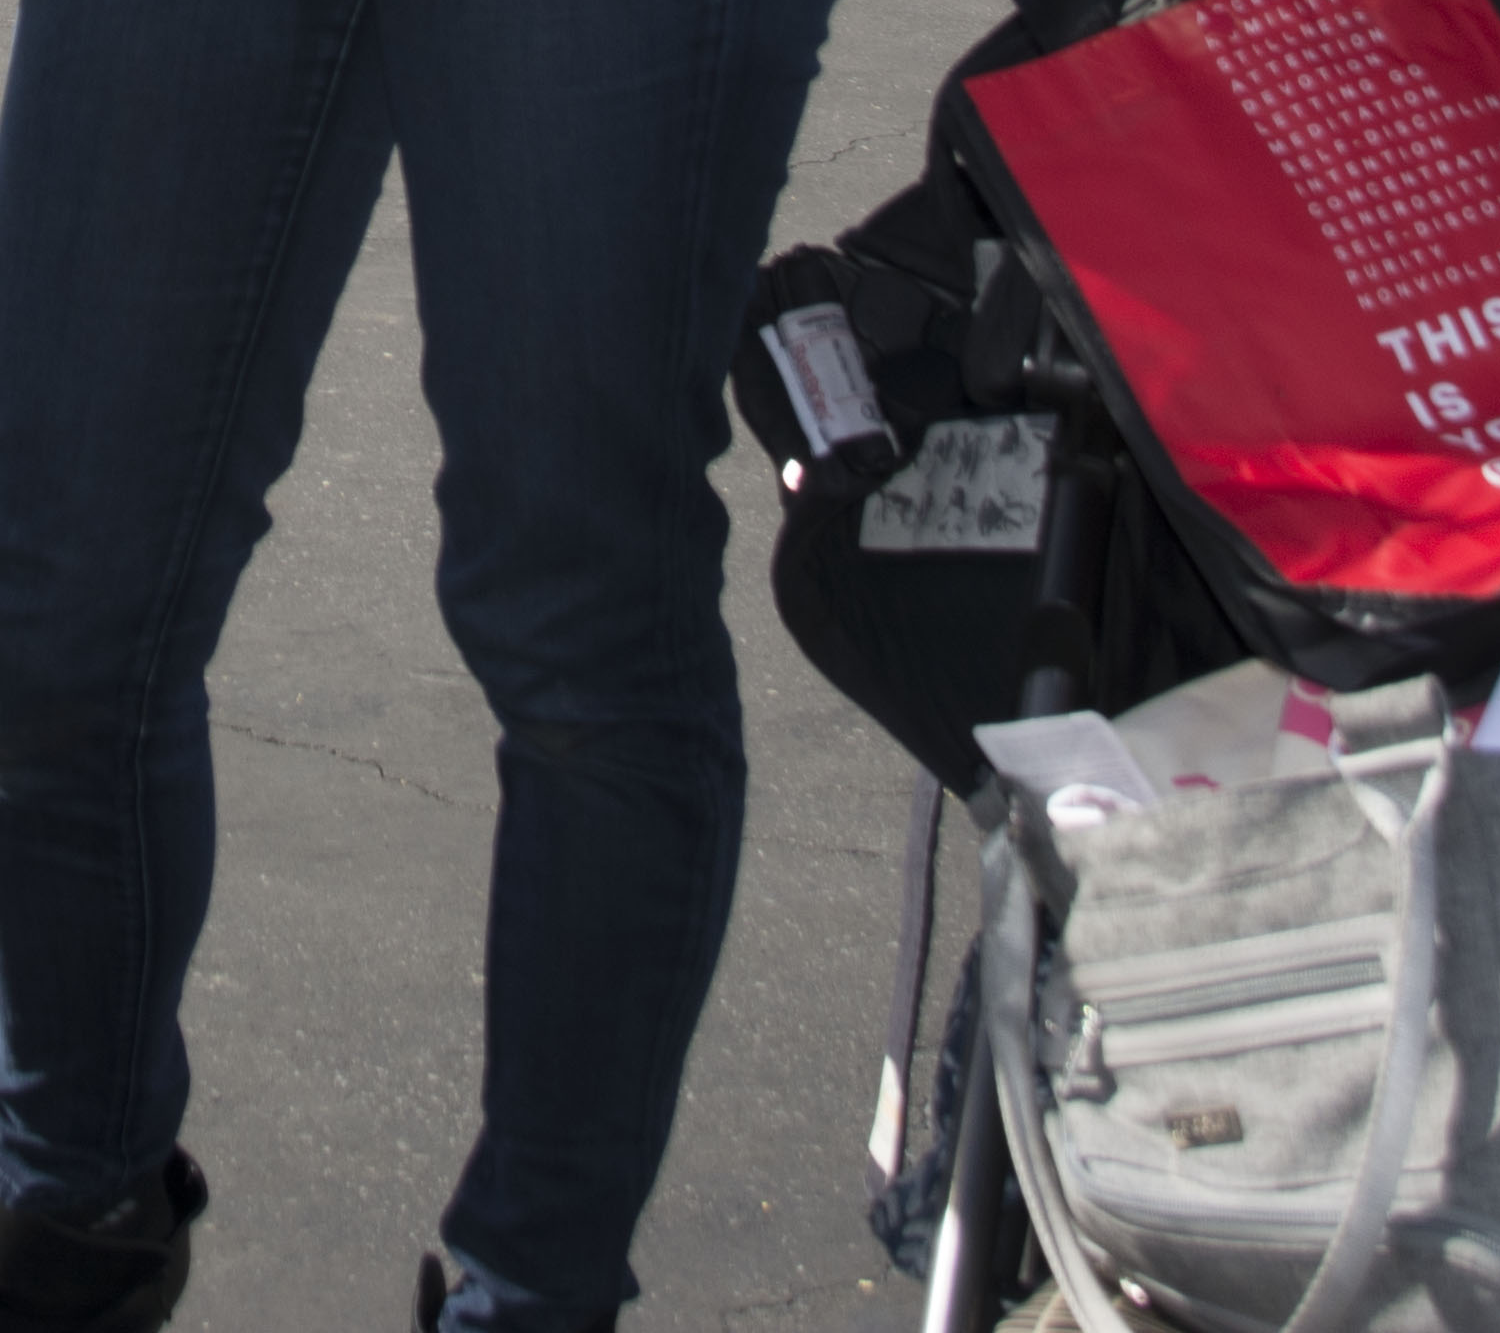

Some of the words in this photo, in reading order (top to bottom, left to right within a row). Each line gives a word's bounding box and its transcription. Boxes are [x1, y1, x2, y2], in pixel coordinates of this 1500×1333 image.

[1215, 10, 1368, 74] STILLNESS
[1231, 26, 1388, 95] ATTENTION
[1241, 51, 1383, 116] DEVOTION
[1254, 77, 1377, 136] LETTING
[1388, 63, 1425, 87] GO
[1267, 84, 1439, 157] MEDITATION
[1294, 134, 1448, 198] INTENTION
[1320, 173, 1492, 240] GENEROSITY
[1345, 242, 1445, 286] PURITY
[1404, 381, 1476, 430] IS
